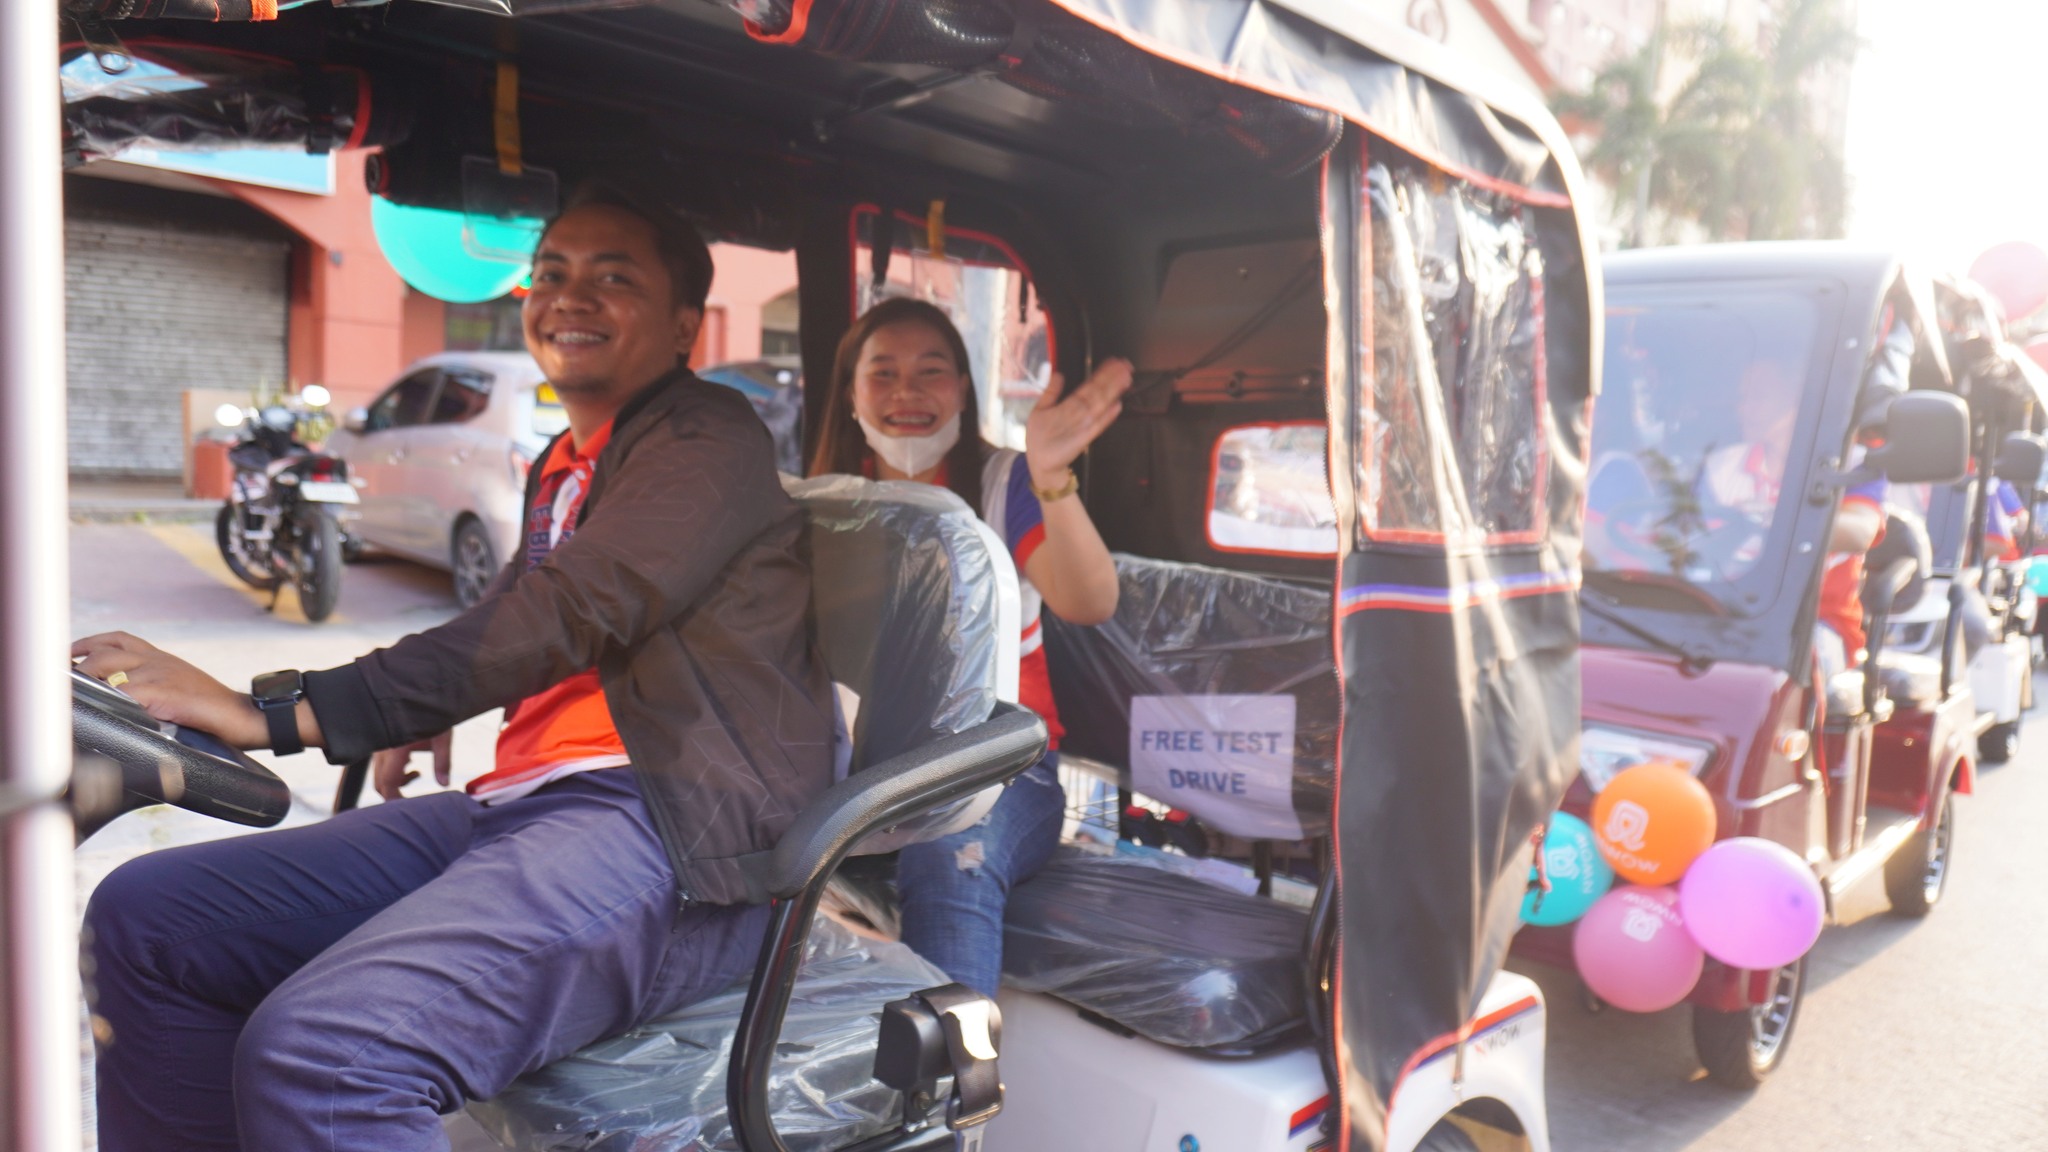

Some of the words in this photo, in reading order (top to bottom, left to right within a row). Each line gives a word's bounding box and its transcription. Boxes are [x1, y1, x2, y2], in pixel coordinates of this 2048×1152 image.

[1140, 730, 1205, 752] FREE
[1212, 731, 1282, 754] TEST
[1168, 768, 1247, 795] DRIVE
